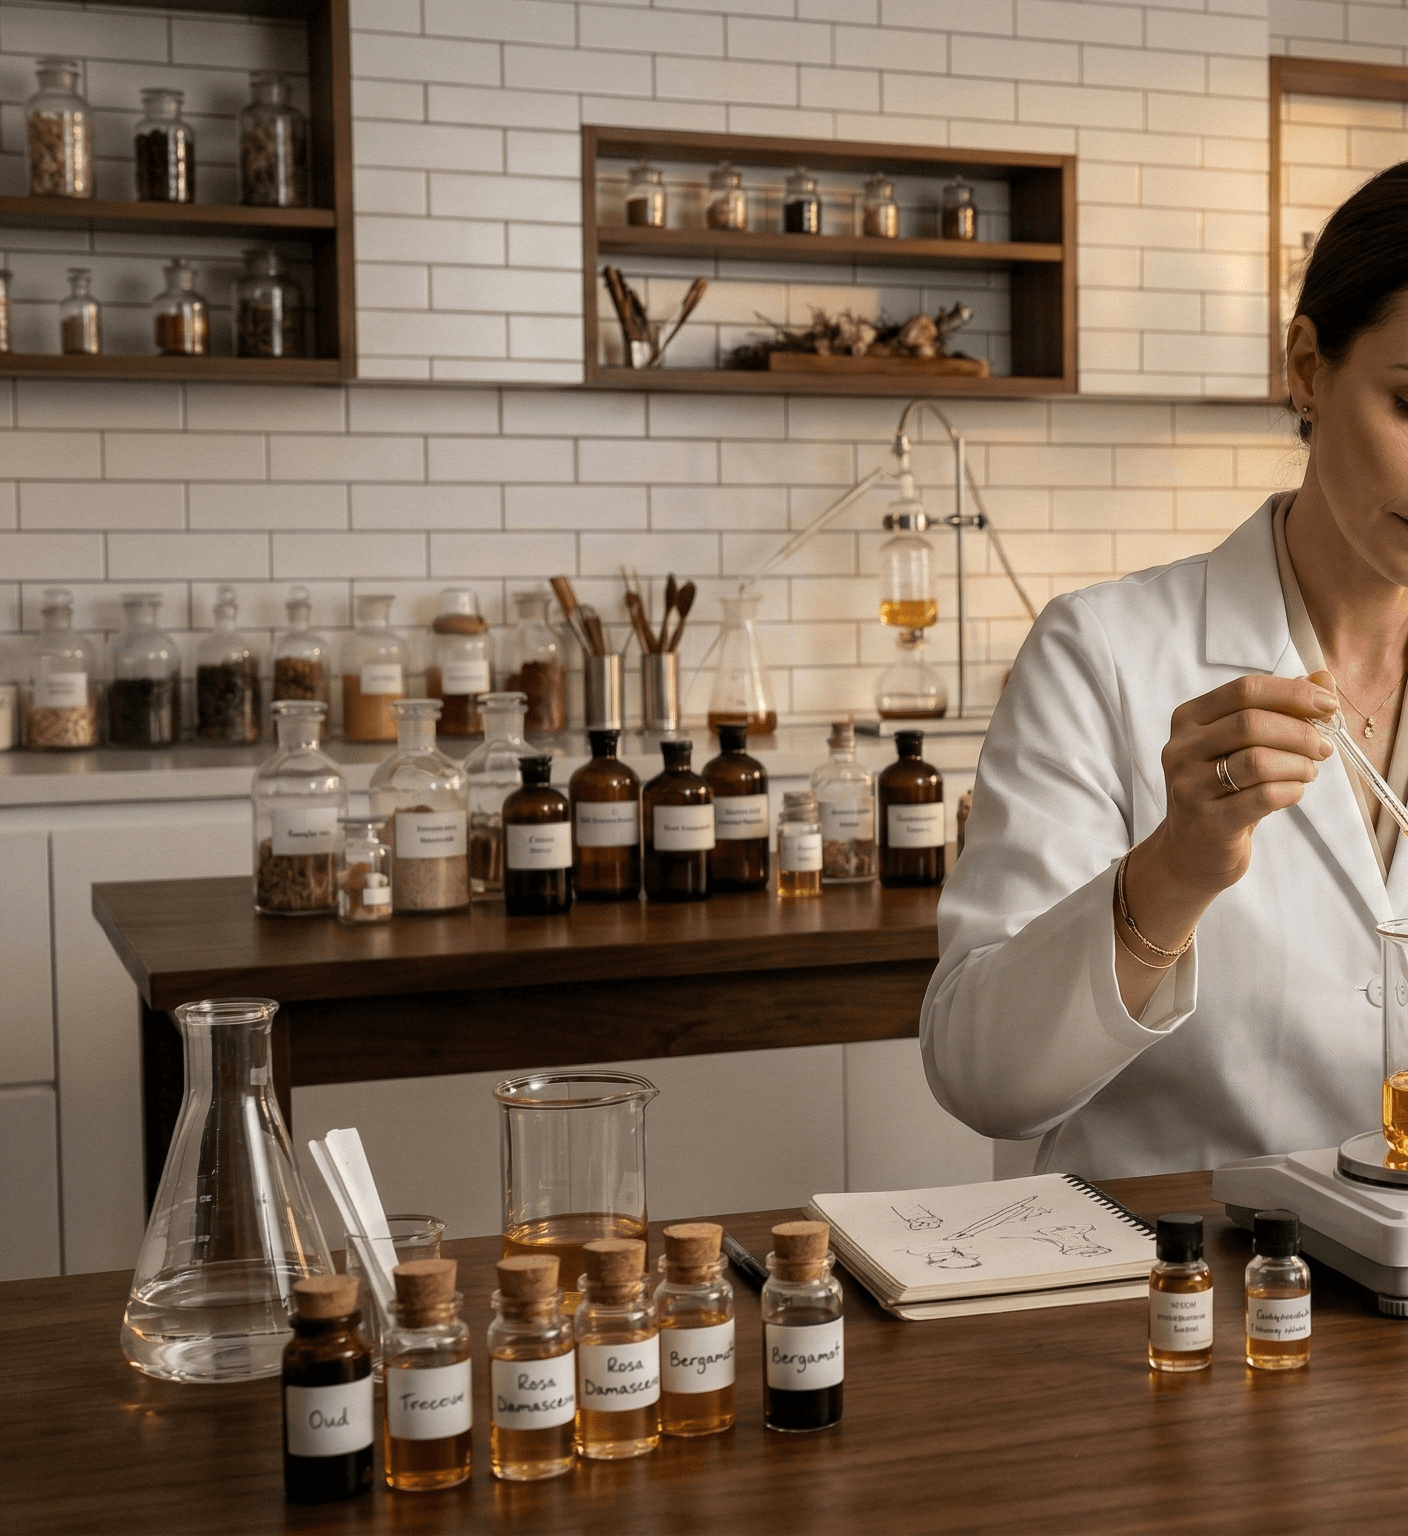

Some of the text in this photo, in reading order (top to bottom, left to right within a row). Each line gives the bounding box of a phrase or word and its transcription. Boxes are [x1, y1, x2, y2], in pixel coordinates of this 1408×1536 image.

[606, 1356, 644, 1373] Rosa
[771, 1341, 841, 1373] Bergamot
[517, 1372, 557, 1391] Rosa
[308, 1407, 350, 1430] Oud
